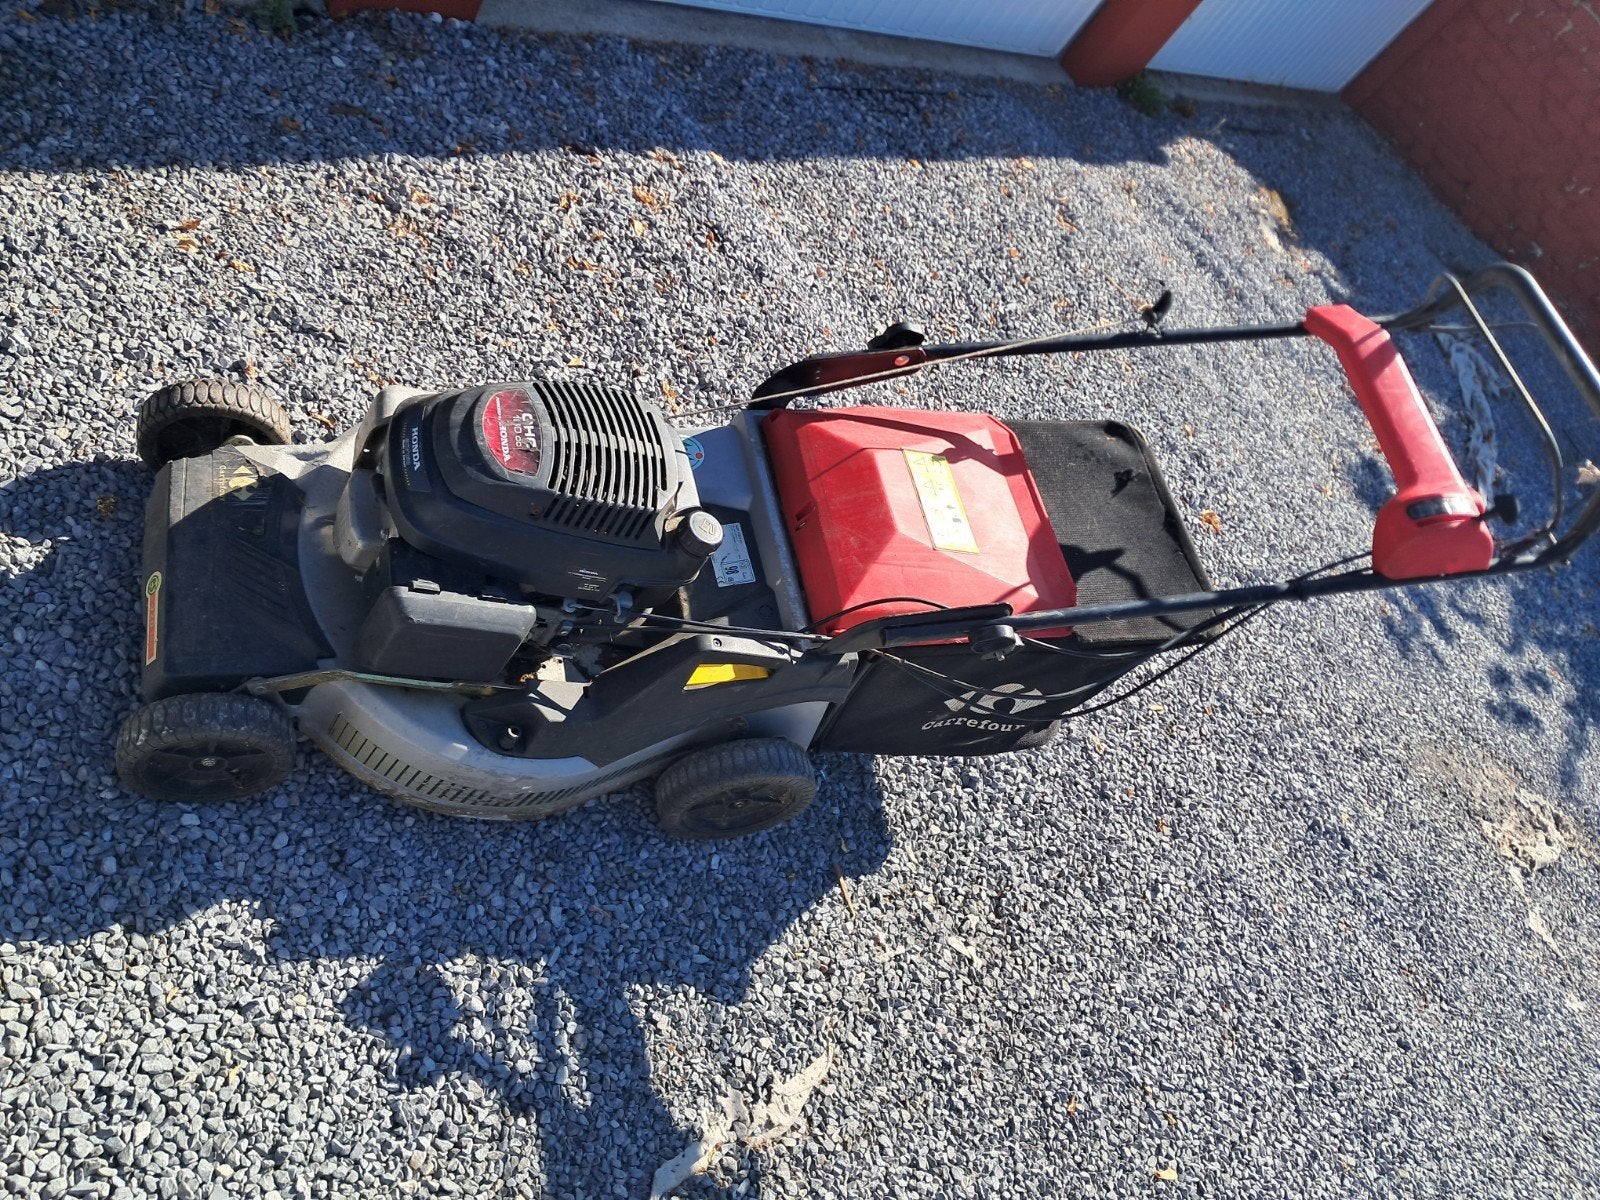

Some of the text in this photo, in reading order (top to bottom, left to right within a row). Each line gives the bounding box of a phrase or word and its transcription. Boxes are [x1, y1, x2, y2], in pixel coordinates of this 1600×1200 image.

[411, 426, 421, 471] HONDA
[499, 424, 511, 463] HONDA
[921, 717, 1026, 732] Carrefour
